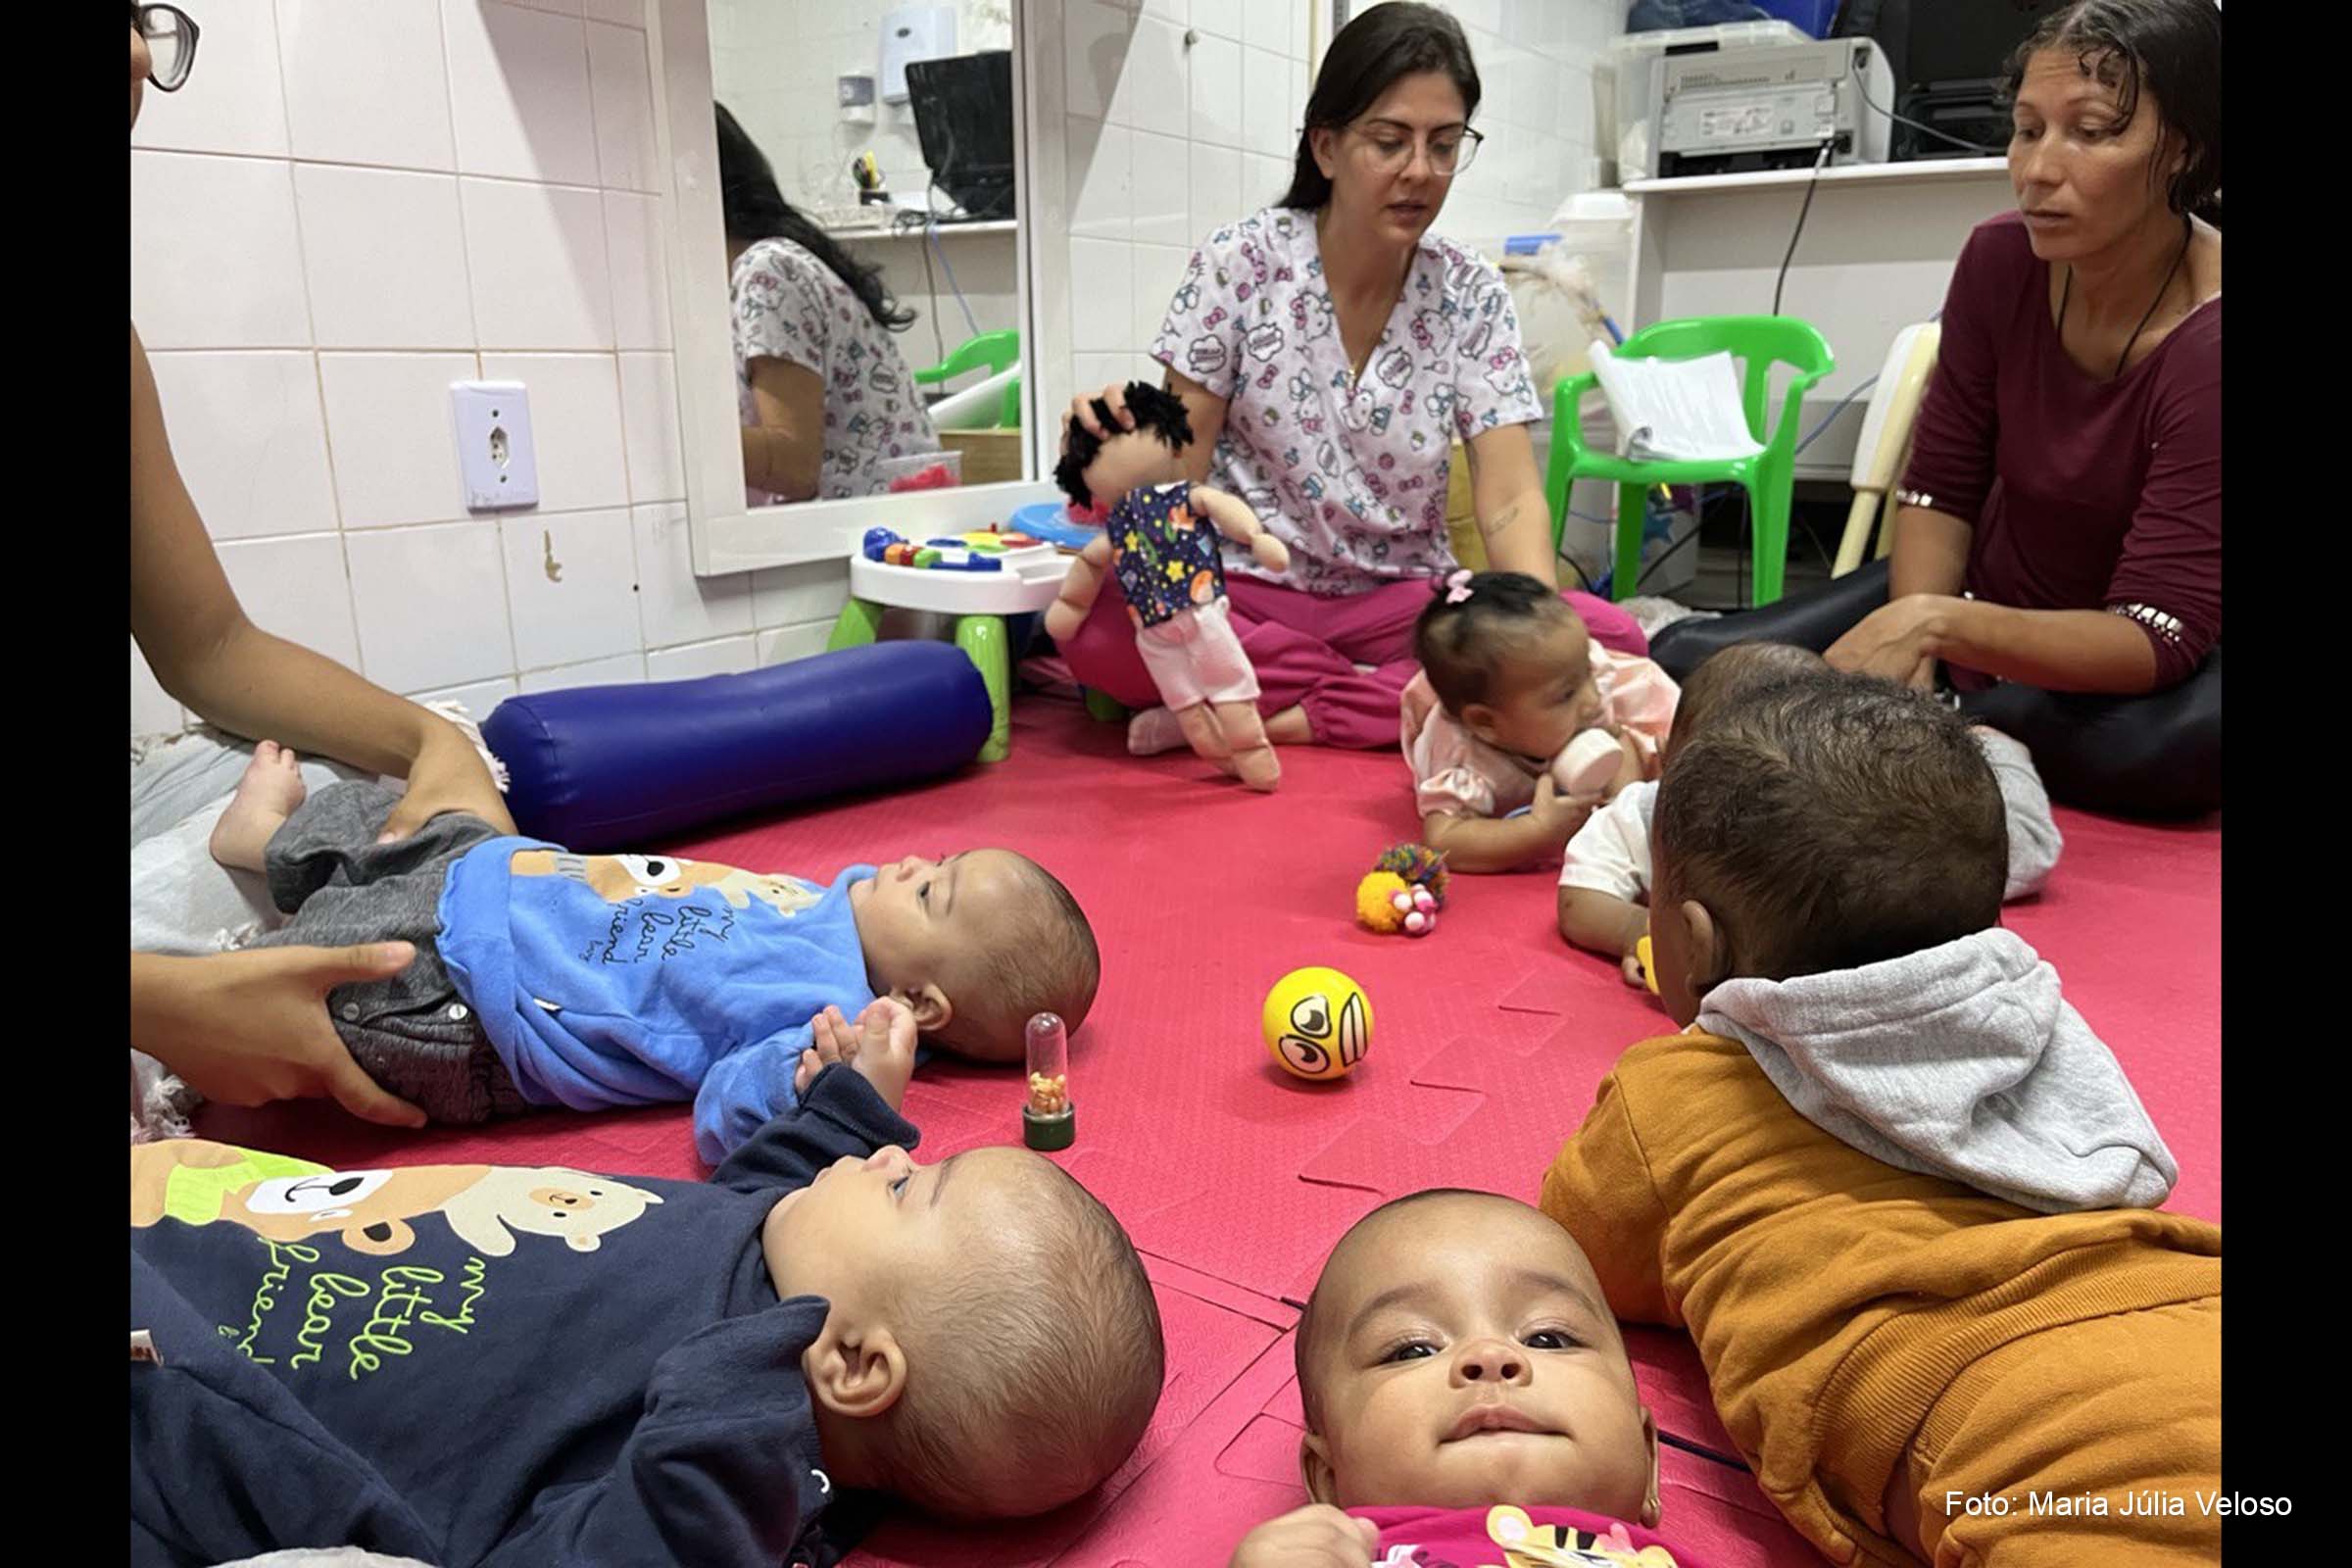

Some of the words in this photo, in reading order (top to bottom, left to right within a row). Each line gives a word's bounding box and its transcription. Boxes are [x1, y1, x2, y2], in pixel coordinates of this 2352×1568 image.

[634, 911, 674, 963] bear
[661, 906, 712, 960] little
[293, 1273, 369, 1369] bear
[350, 1266, 444, 1381] little
[420, 1257, 486, 1334] my
